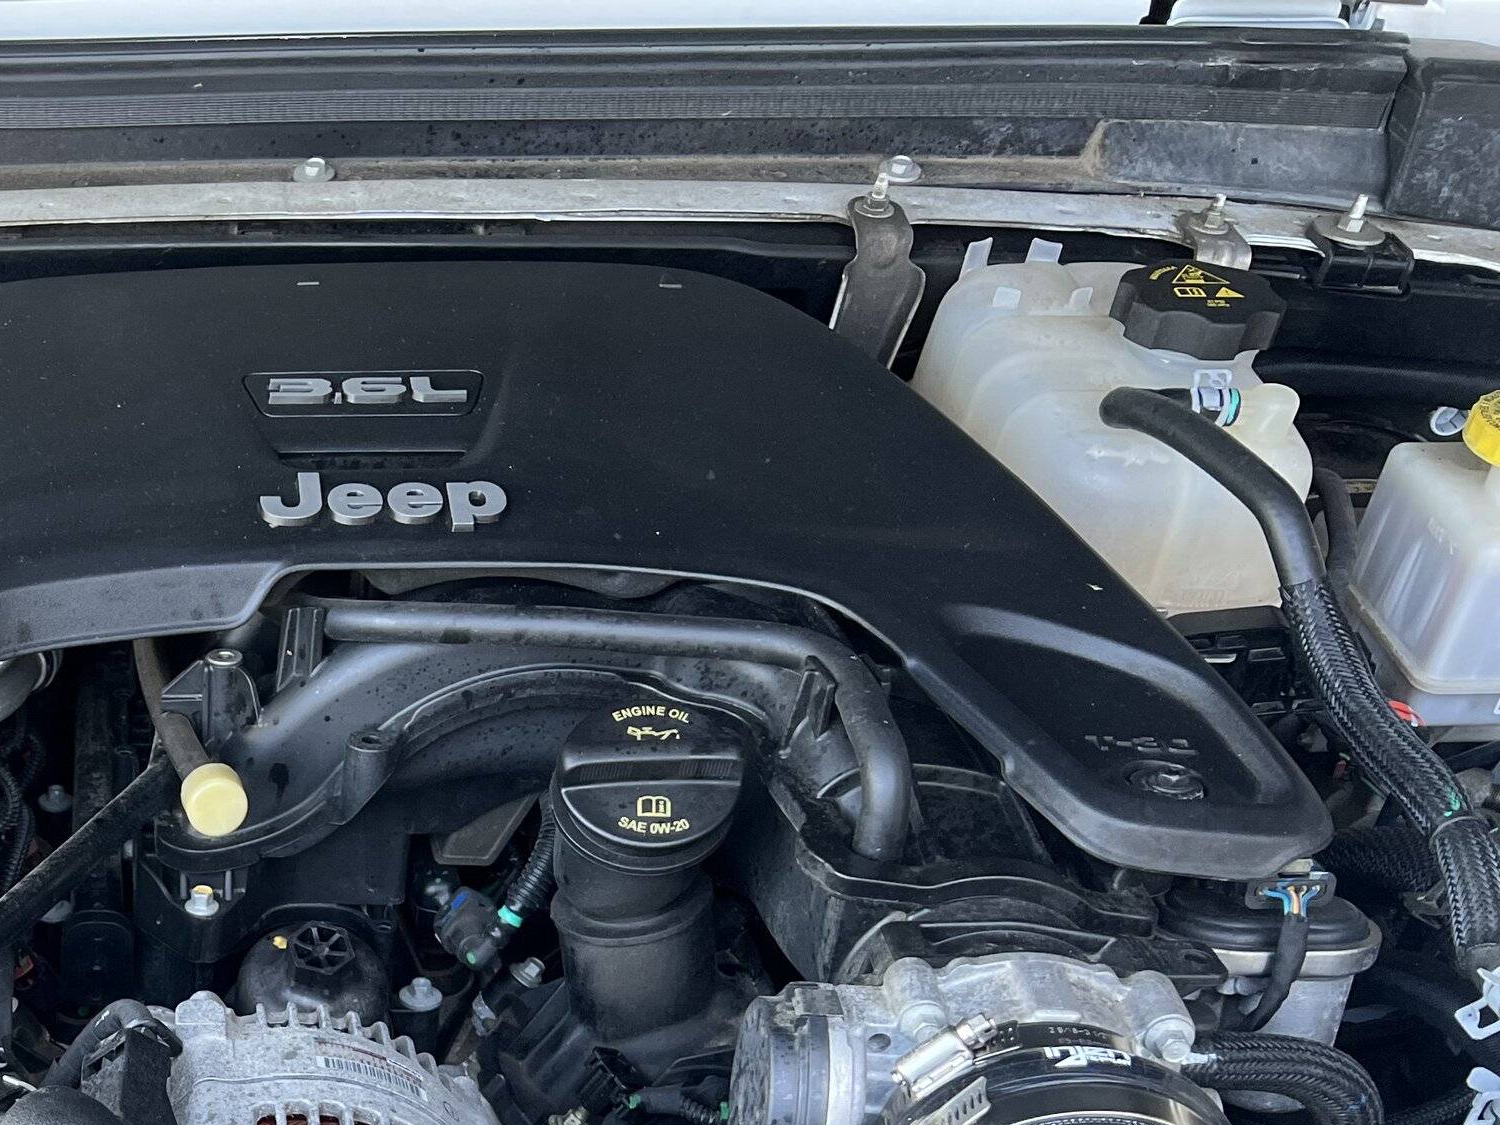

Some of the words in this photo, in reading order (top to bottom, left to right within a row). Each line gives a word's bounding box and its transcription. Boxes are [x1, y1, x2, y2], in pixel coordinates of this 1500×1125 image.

[267, 375, 468, 405] 3.6L
[259, 471, 508, 533] Jeep
[612, 705, 666, 722] ENGINE
[668, 707, 690, 724] OIL
[617, 816, 648, 834] SAE
[649, 818, 690, 835] 0W-20
